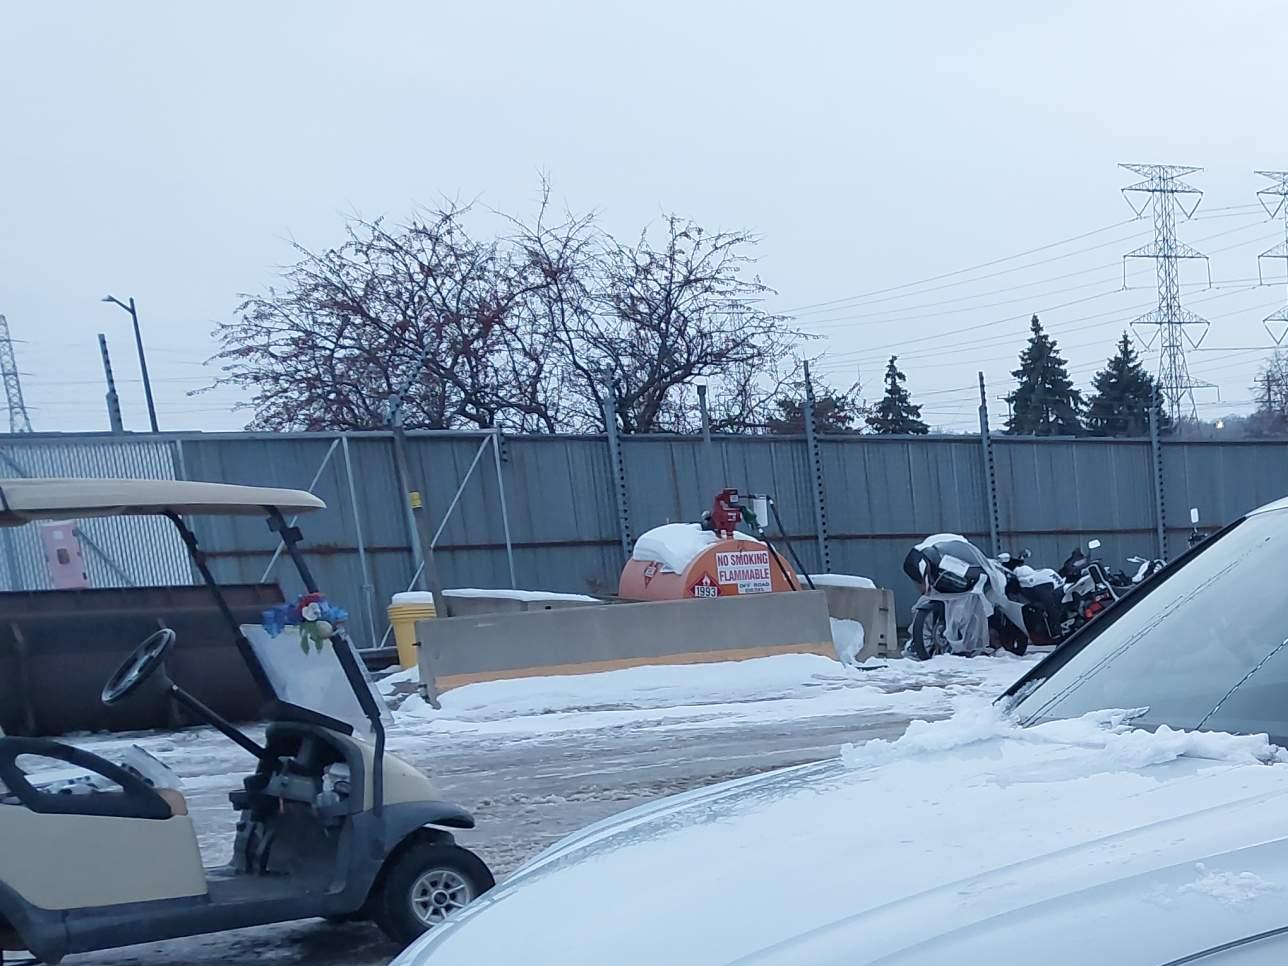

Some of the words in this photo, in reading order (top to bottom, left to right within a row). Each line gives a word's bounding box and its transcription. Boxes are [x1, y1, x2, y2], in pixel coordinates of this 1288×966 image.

[717, 554, 729, 567] NO
[730, 552, 768, 566] SMOKING
[719, 568, 769, 582] FLAMMABLE
[696, 587, 716, 597] 1993
